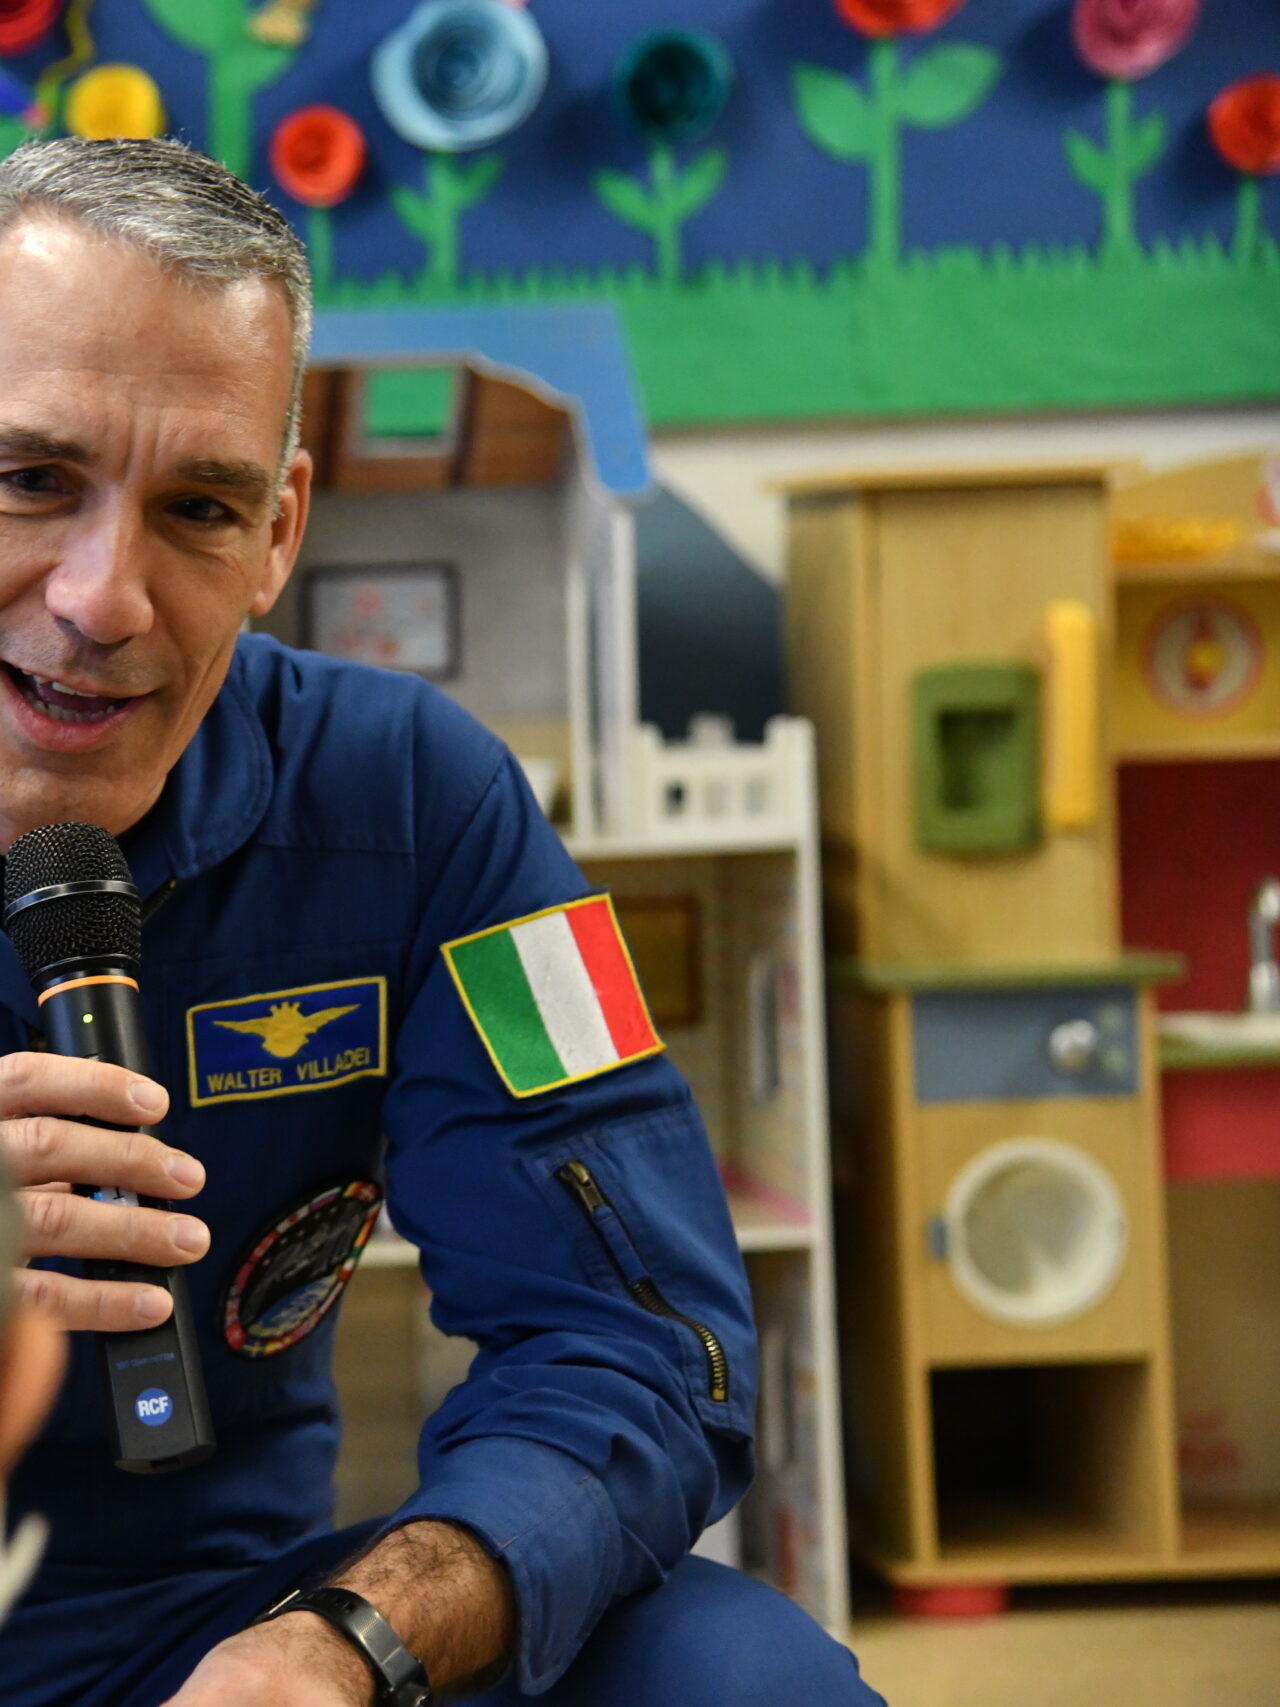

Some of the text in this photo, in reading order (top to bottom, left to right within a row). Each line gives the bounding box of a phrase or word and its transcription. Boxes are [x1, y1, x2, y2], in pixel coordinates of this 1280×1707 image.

[207, 1048, 370, 1093] WALTER VILLADEI
[137, 1396, 169, 1417] RCF
